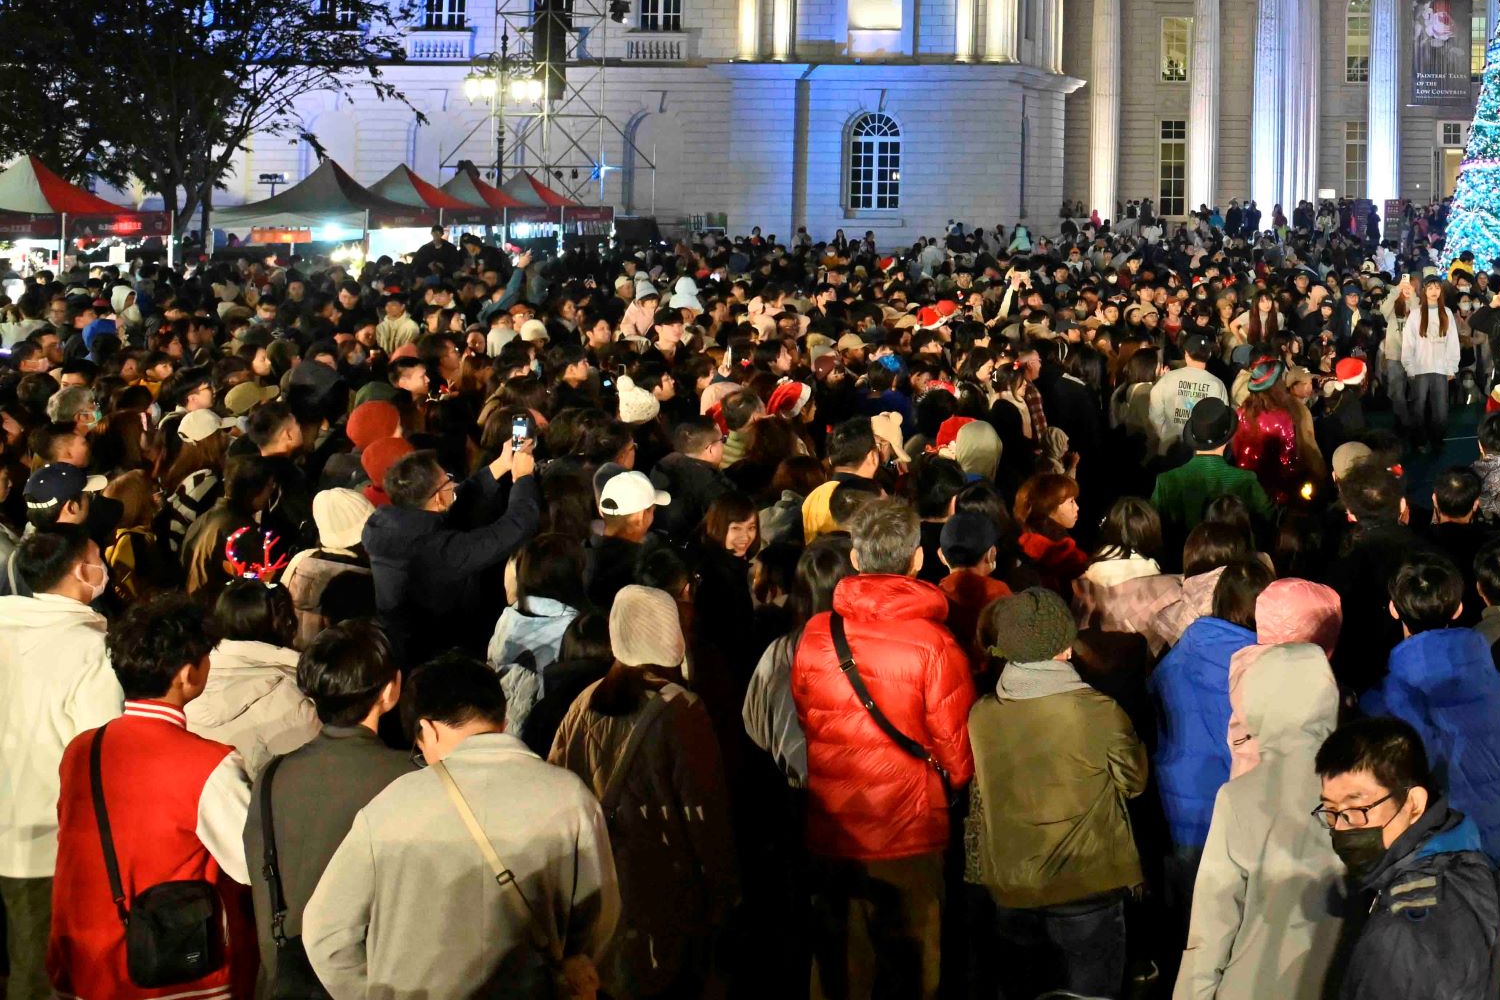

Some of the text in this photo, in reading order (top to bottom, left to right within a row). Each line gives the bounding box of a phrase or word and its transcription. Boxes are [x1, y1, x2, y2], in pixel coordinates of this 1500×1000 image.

[1178, 380, 1211, 392] DON'T LET
[1174, 407, 1191, 419] RUIN
